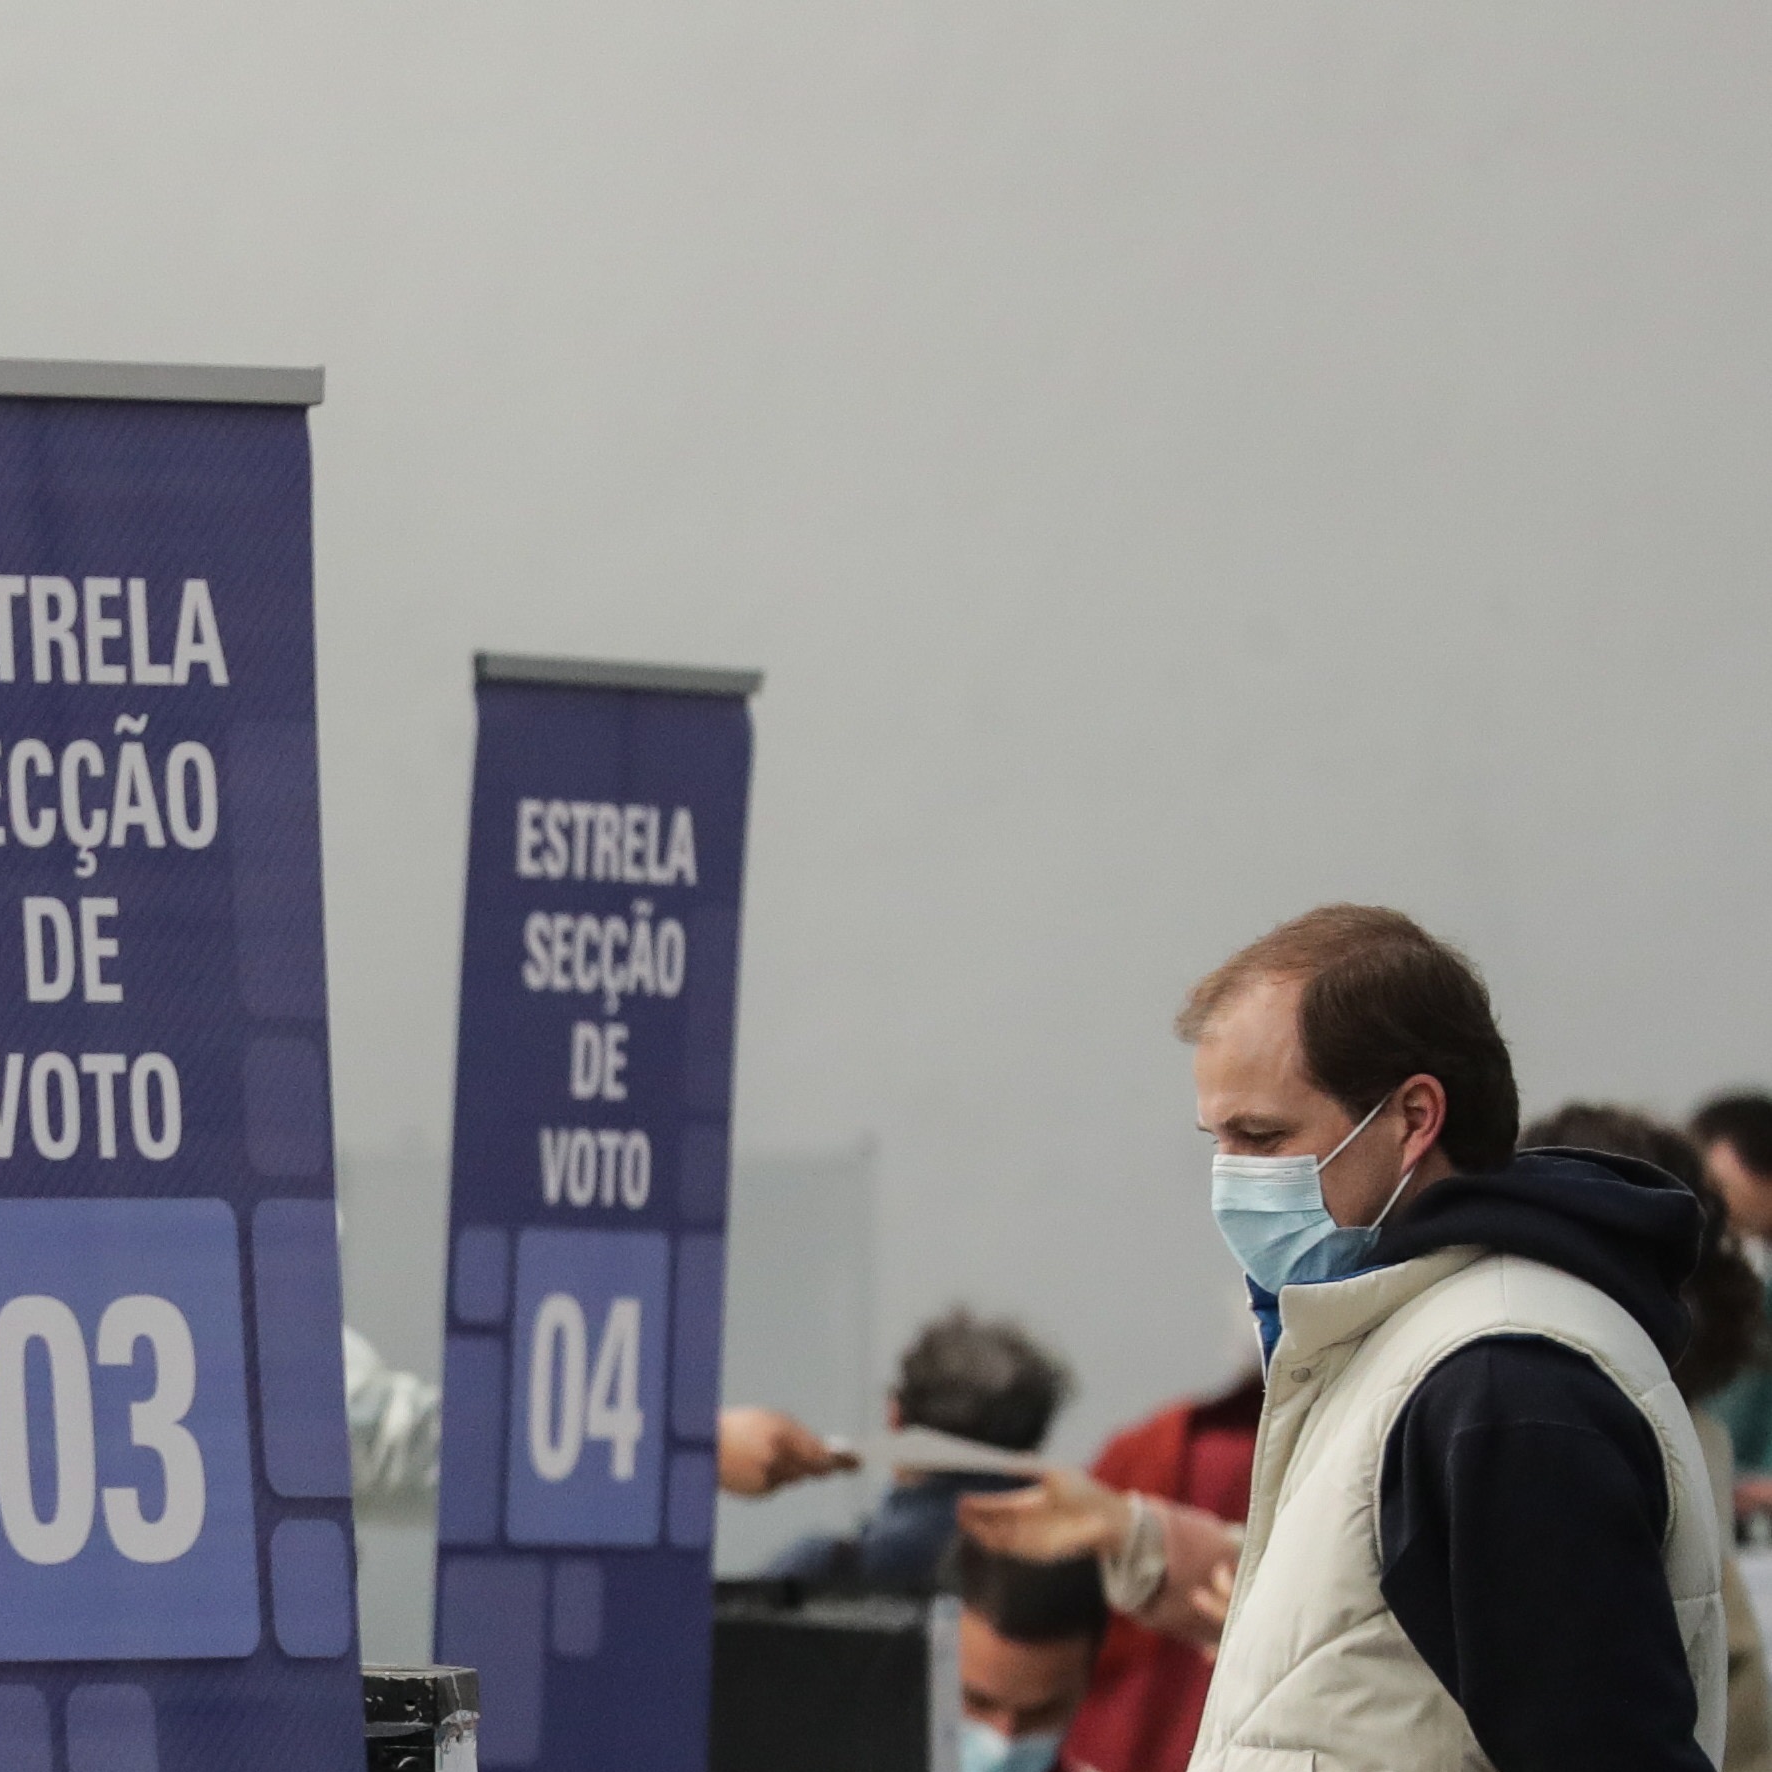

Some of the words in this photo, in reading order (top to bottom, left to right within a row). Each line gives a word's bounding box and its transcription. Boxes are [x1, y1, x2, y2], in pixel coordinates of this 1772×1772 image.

[517, 799, 696, 885] ESTRELA
[23, 897, 122, 1004] DE
[523, 901, 685, 1013] SECÇÃO
[570, 1022, 629, 1100] DE
[540, 1128, 651, 1209] VOTO
[528, 1292, 644, 1482] 04
